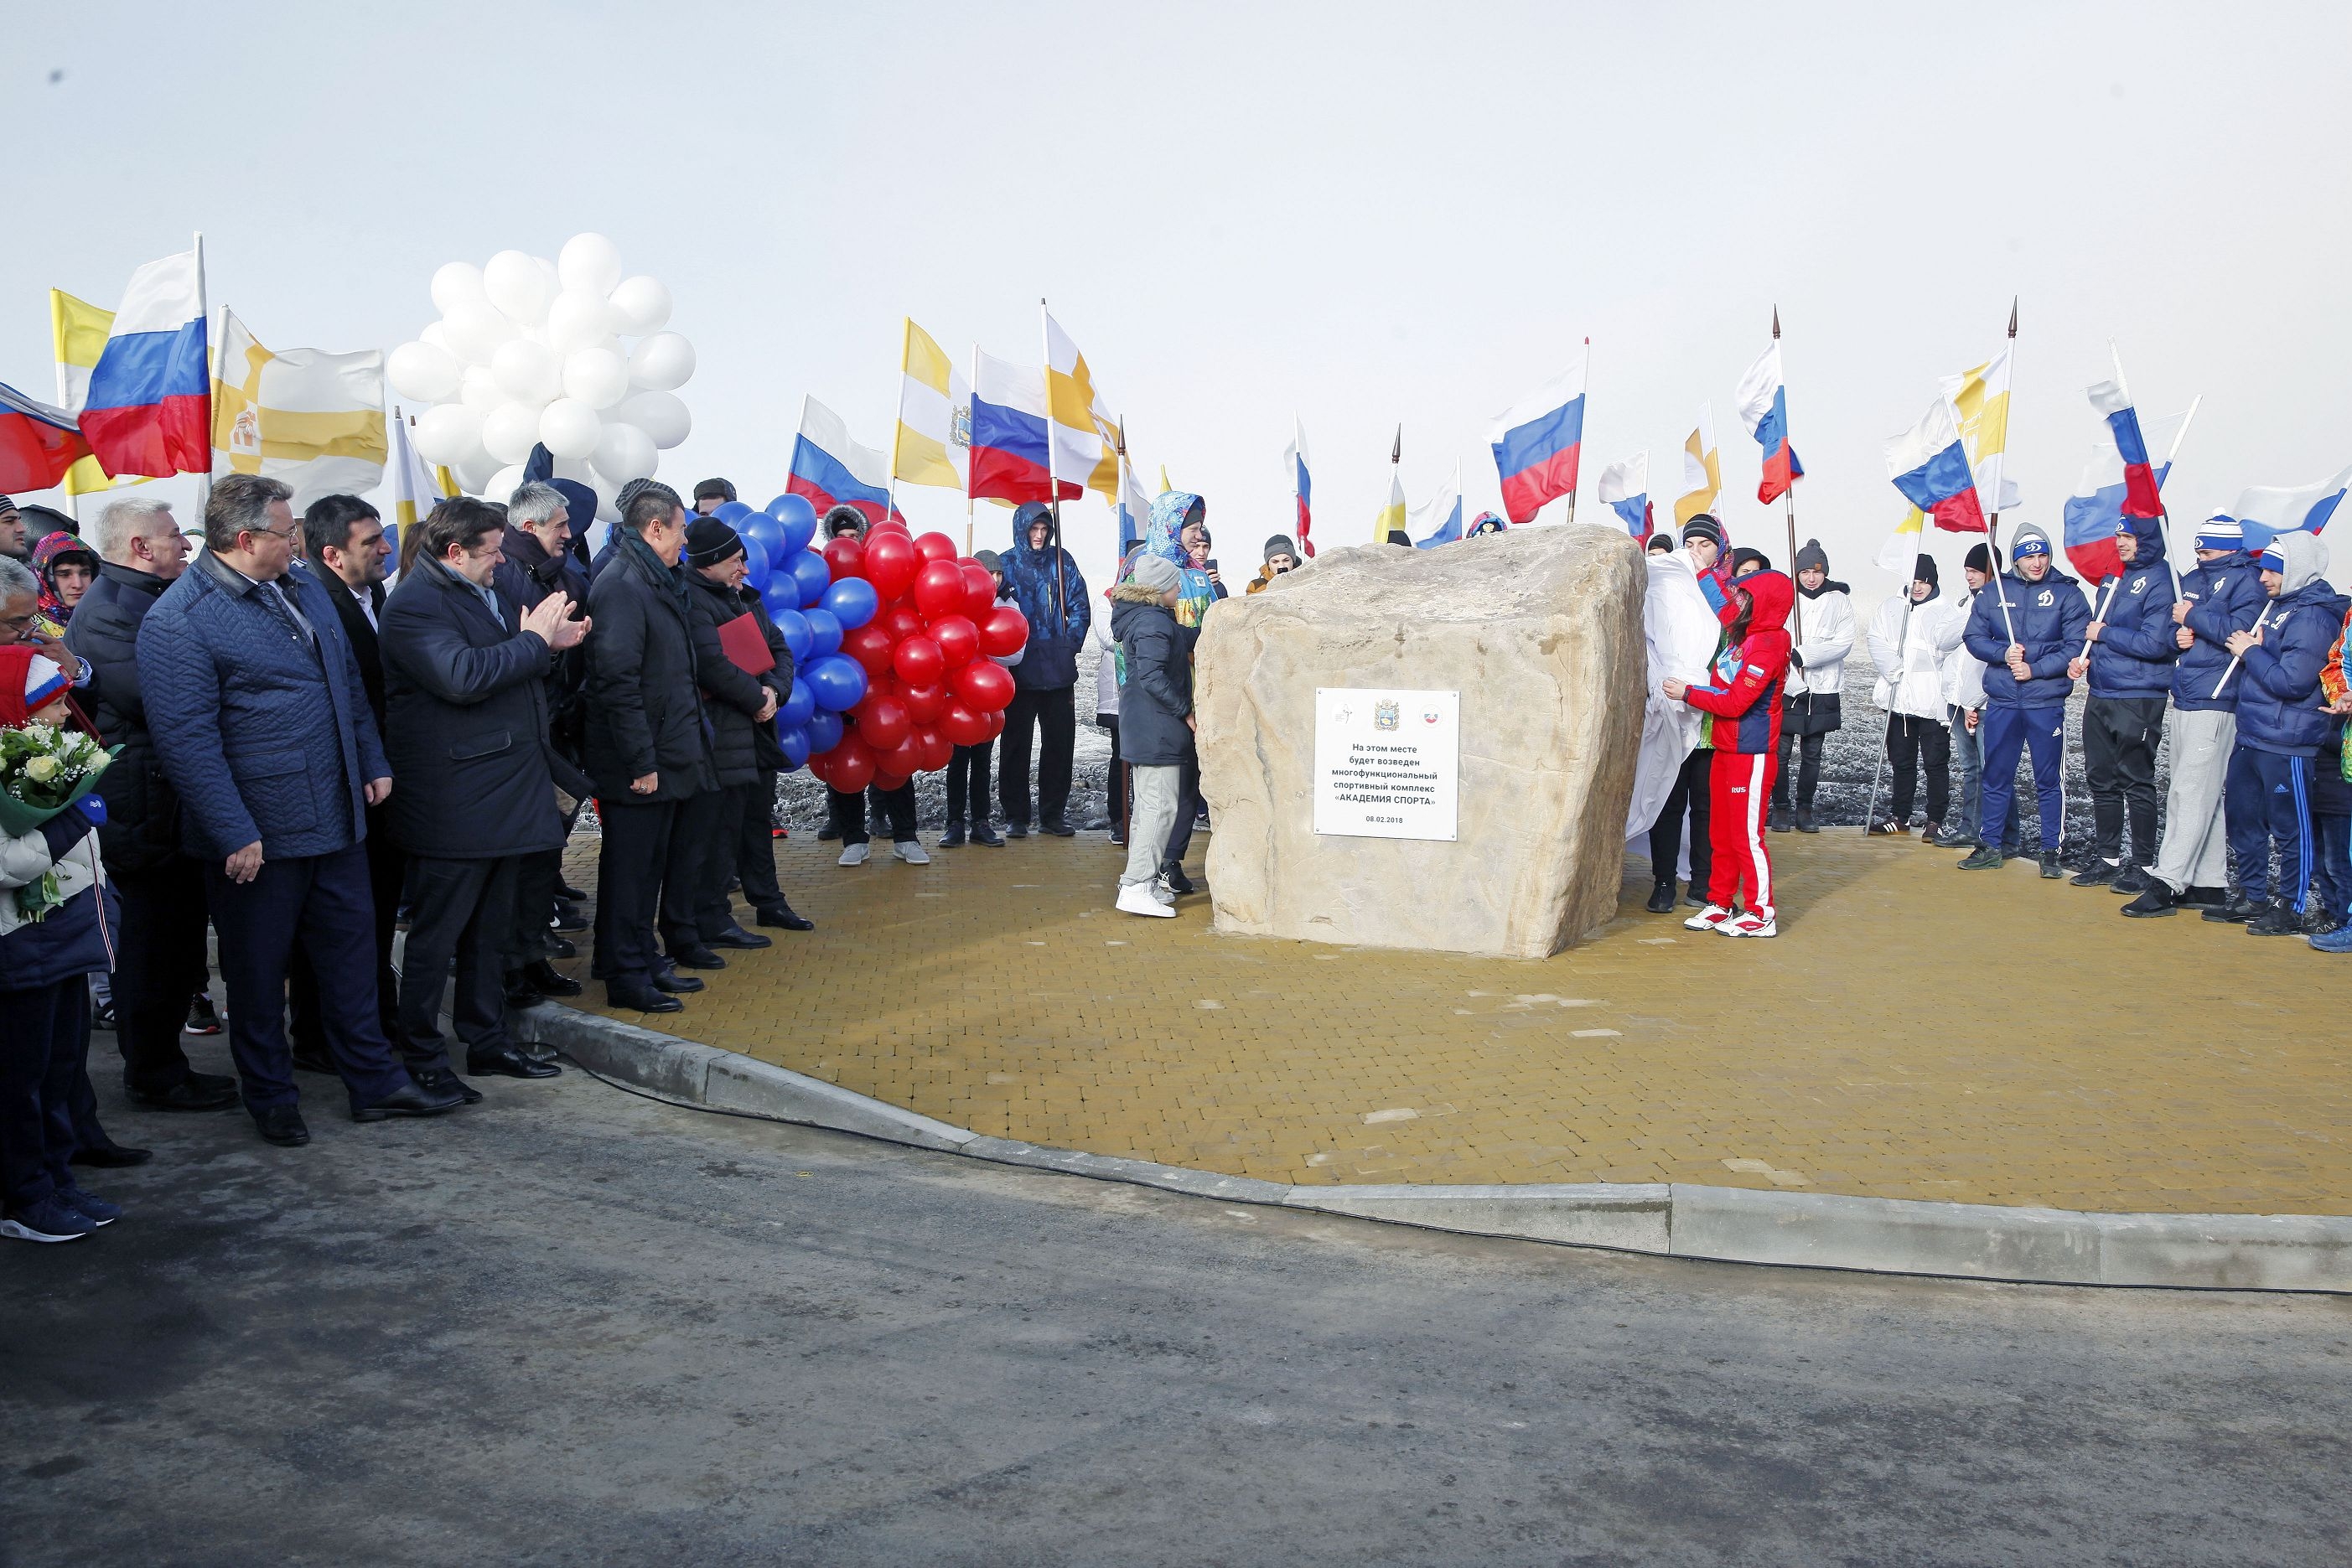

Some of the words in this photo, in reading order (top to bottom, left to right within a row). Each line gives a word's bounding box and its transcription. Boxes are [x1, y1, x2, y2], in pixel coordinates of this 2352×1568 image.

[1352, 743, 1365, 752] На
[1349, 755, 1375, 765] будет
[1377, 758, 1420, 767] возведен
[1331, 768, 1438, 779] многофункциональный
[1333, 782, 1388, 791] спортивный
[1391, 784, 1435, 793] комплекс
[1334, 794, 1391, 804] «АКАДЕМИЯ
[1393, 796, 1436, 805] СПОРТА»
[1365, 815, 1403, 824] 08.02.2018
